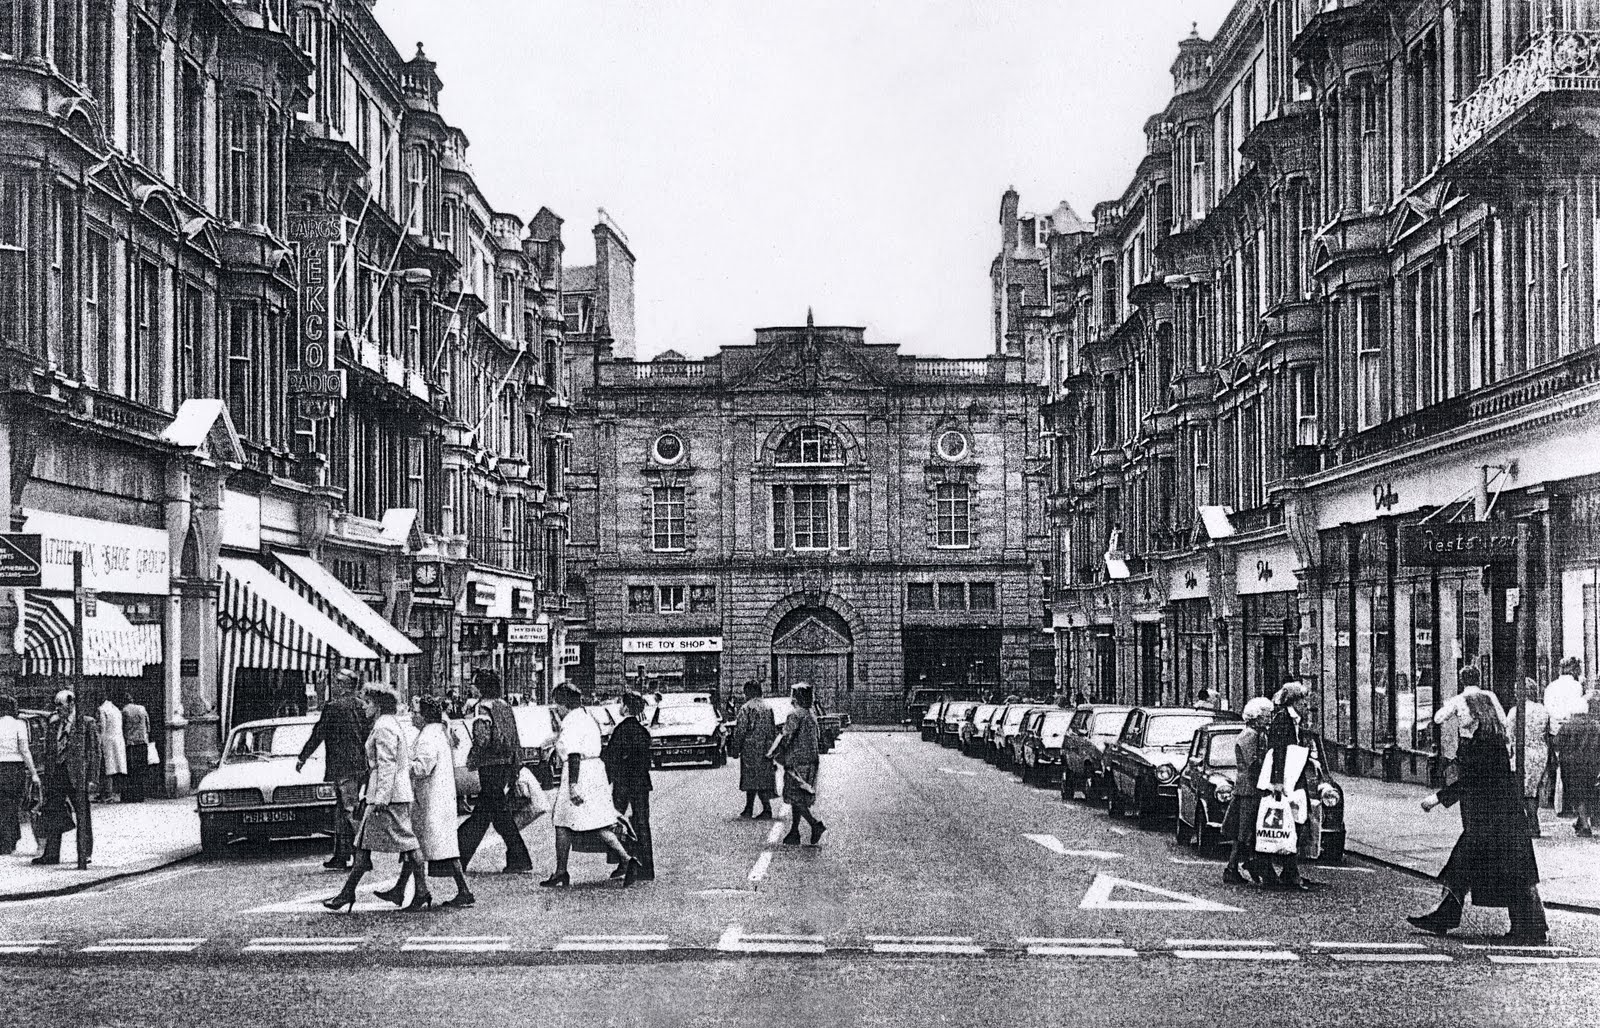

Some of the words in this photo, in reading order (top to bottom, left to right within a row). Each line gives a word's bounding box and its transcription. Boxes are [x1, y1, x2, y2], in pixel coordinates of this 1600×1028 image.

[305, 258, 326, 368] EKCO
[288, 373, 341, 393] RADIO
[636, 641, 654, 649] THE
[658, 641, 675, 649] TOY
[679, 640, 705, 648] SHOP
